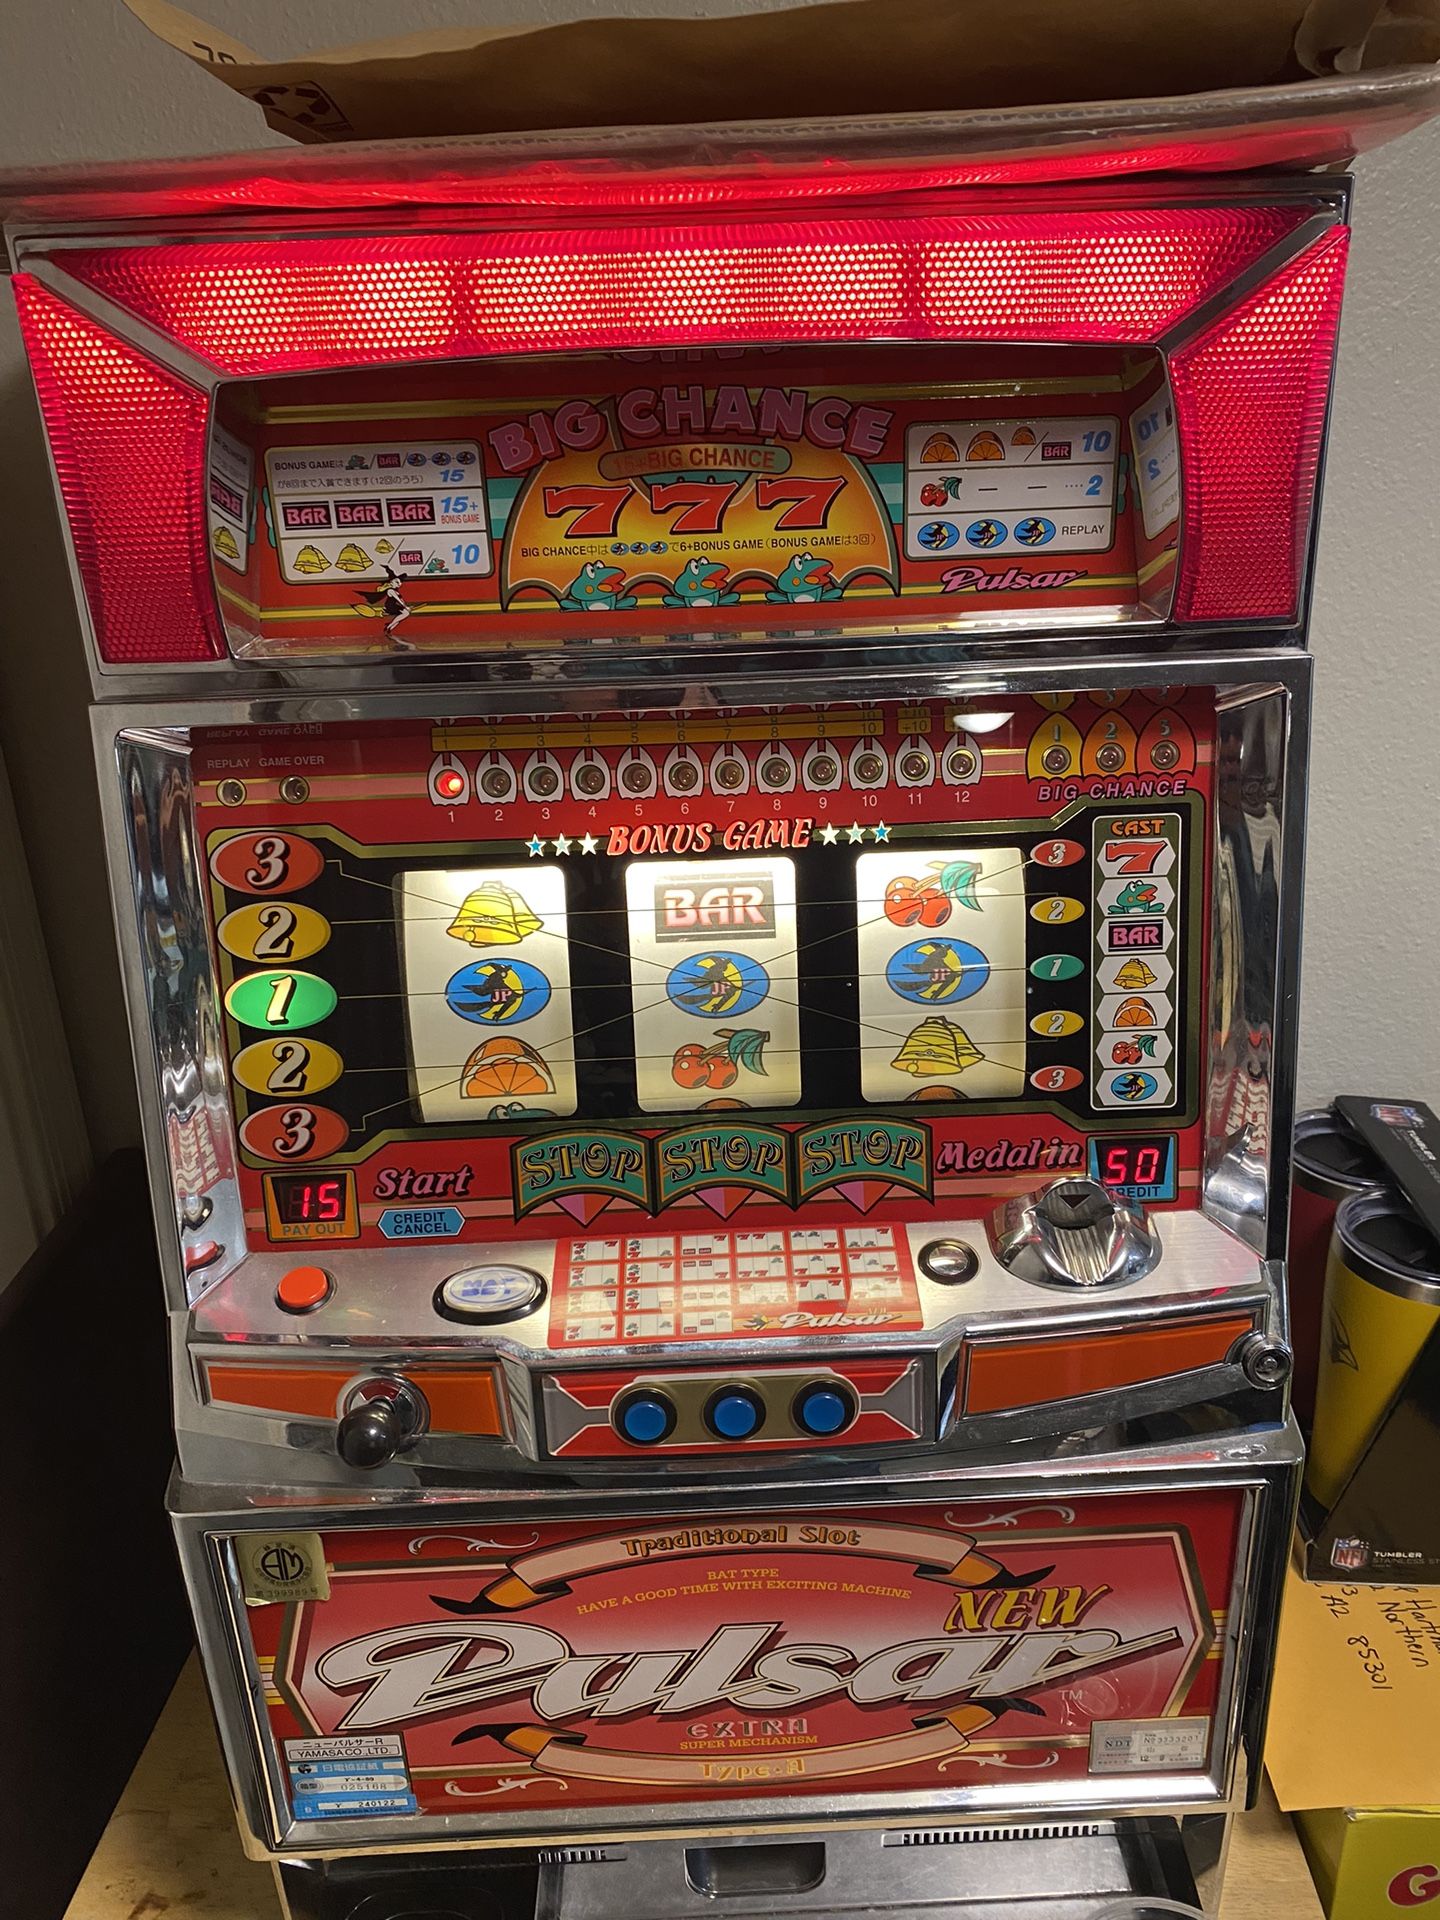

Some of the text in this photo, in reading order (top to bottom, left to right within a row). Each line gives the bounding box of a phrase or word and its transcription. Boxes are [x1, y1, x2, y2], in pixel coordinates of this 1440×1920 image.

[489, 385, 894, 473] BIG CHANCE
[1082, 431, 1112, 452] 10
[688, 446, 776, 469] CHANCE
[1042, 445, 1070, 458] BAR
[274, 461, 306, 471] BONUS
[440, 469, 465, 483] 15
[1085, 475, 1103, 496] 2
[285, 503, 431, 525] BAR BAR BAR
[544, 476, 848, 539] 7 7 7
[440, 513, 480, 525] BONUS GAME
[1061, 524, 1105, 536] REPLAY
[400, 553, 421, 563] BAR
[452, 544, 480, 565] 10
[521, 547, 540, 558] BIG
[732, 539, 764, 550] GAME
[940, 567, 1088, 594] Pulsar
[1104, 722, 1118, 739] 2
[206, 758, 250, 770] REPLAY
[258, 754, 325, 768] GAME OVER
[907, 793, 923, 805] 11
[954, 791, 970, 803] 12
[1037, 779, 1187, 802] BIG CHANCE
[634, 803, 644, 816] 5
[680, 802, 690, 815] 6
[726, 800, 736, 813] 7
[772, 798, 782, 811] 8
[818, 796, 828, 809] 9
[862, 795, 878, 807] 10
[447, 810, 455, 823] 1
[494, 809, 504, 822] 2
[541, 807, 551, 820] 3
[588, 805, 598, 818] 4
[606, 818, 814, 856] BONUS GAME
[1111, 818, 1165, 837] CAST
[245, 836, 291, 890] 3
[1047, 843, 1067, 864] 3
[662, 886, 768, 928] BAR
[1050, 899, 1067, 921] 2
[253, 905, 297, 959] 2
[1111, 926, 1160, 946] BAR
[1049, 958, 1063, 977] 1
[265, 974, 297, 1026] 1
[1049, 1013, 1066, 1034] 2
[267, 1040, 311, 1093] 2
[1049, 1069, 1066, 1087] 3
[273, 1107, 317, 1158] 3
[663, 1134, 782, 1183] STOP
[802, 1128, 924, 1177] STOP
[935, 1137, 1081, 1175] Medal in
[521, 1142, 641, 1191] STOP
[1105, 1148, 1160, 1186] 50
[374, 1165, 474, 1200] Start
[301, 1182, 340, 1219] 15
[393, 1211, 446, 1224] CREDIT
[282, 1222, 345, 1237] PAY OUT
[393, 1222, 452, 1235] CANCEL
[778, 1311, 903, 1330] Pulsar
[619, 1525, 862, 1558] Traditional Slot
[706, 1568, 779, 1581] BAT TYPE
[576, 1579, 913, 1615] HAVE A GOOD TIME WITH EXCITING MACHINE
[943, 1584, 1112, 1632] NEW
[1346, 1634, 1393, 1690] 85301
[314, 1620, 1183, 1732] Pulsar
[1058, 1688, 1083, 1701] TM
[679, 1735, 818, 1751] SUPER MECHANISM
